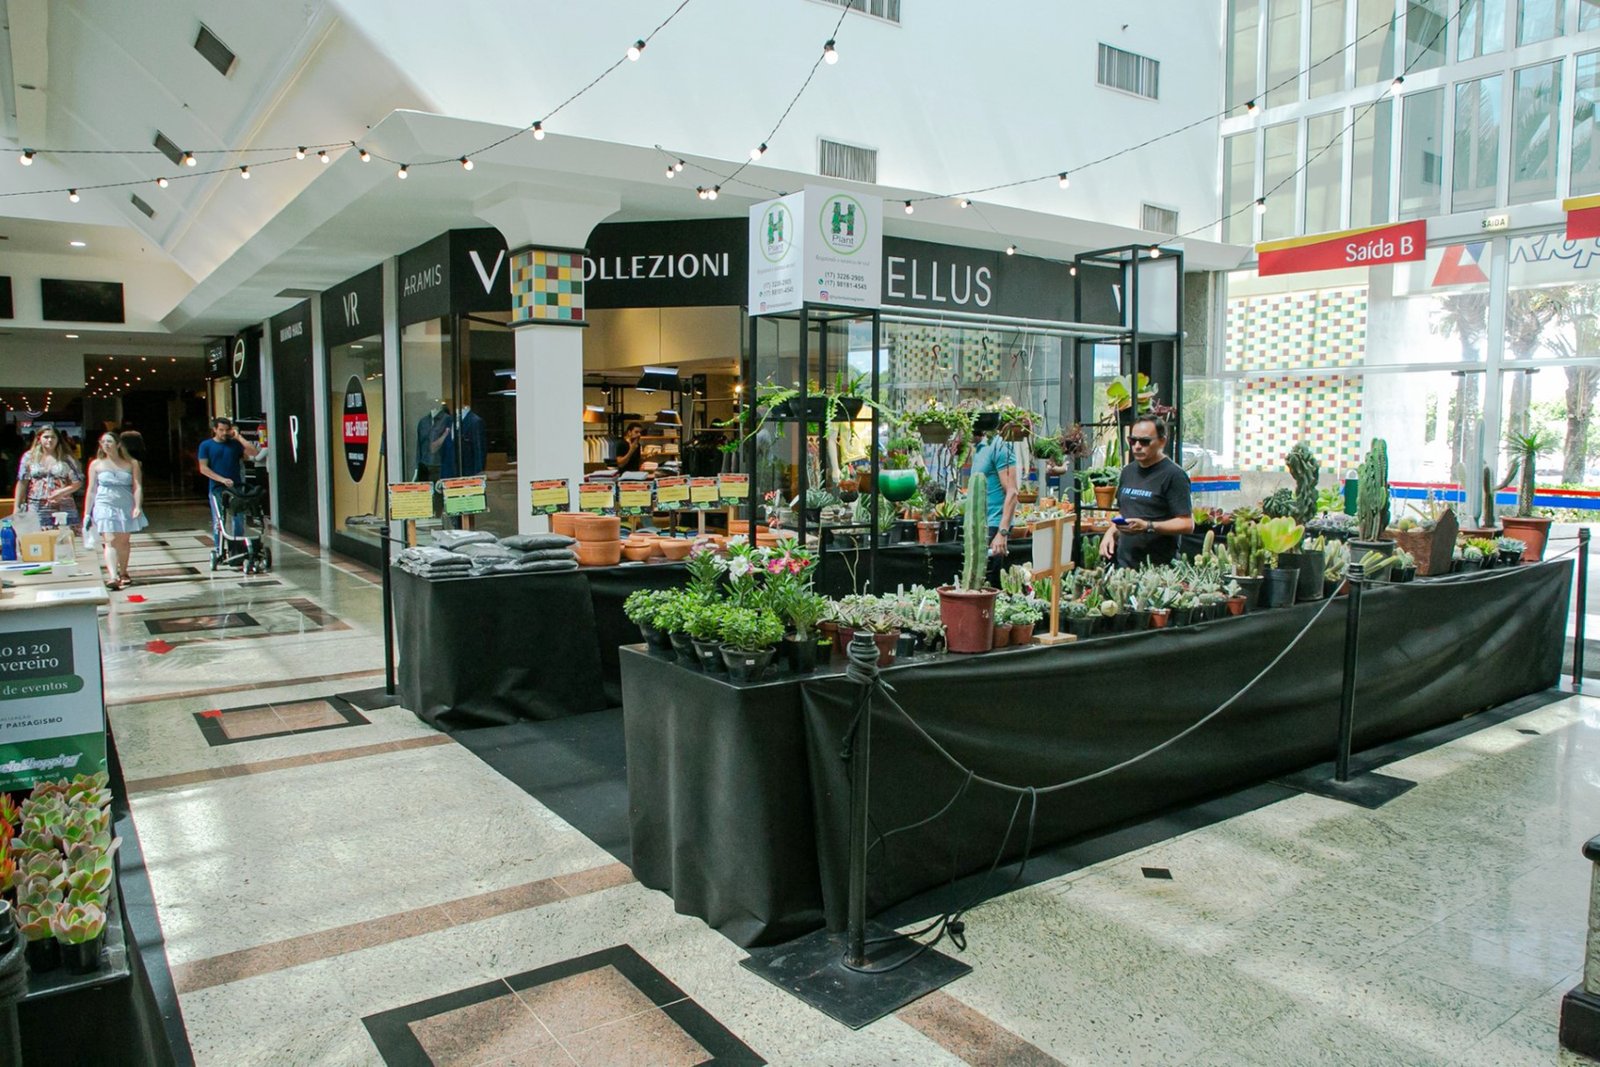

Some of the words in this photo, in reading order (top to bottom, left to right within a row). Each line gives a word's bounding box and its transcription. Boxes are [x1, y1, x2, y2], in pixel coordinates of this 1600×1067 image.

[1345, 238, 1394, 262] Saída
[1400, 236, 1414, 255] B
[403, 264, 442, 297] ARAMIS
[469, 250, 512, 295] V
[583, 253, 729, 281] OLLEZIONI
[888, 256, 992, 307] ELLUS
[343, 292, 360, 327] VR
[0, 647, 13, 657] 0
[17, 645, 26, 655] a
[31, 643, 50, 654] 20
[3, 685, 18, 695] de
[21, 682, 69, 693] eventos
[6, 717, 63, 729] PAISAGISMO
